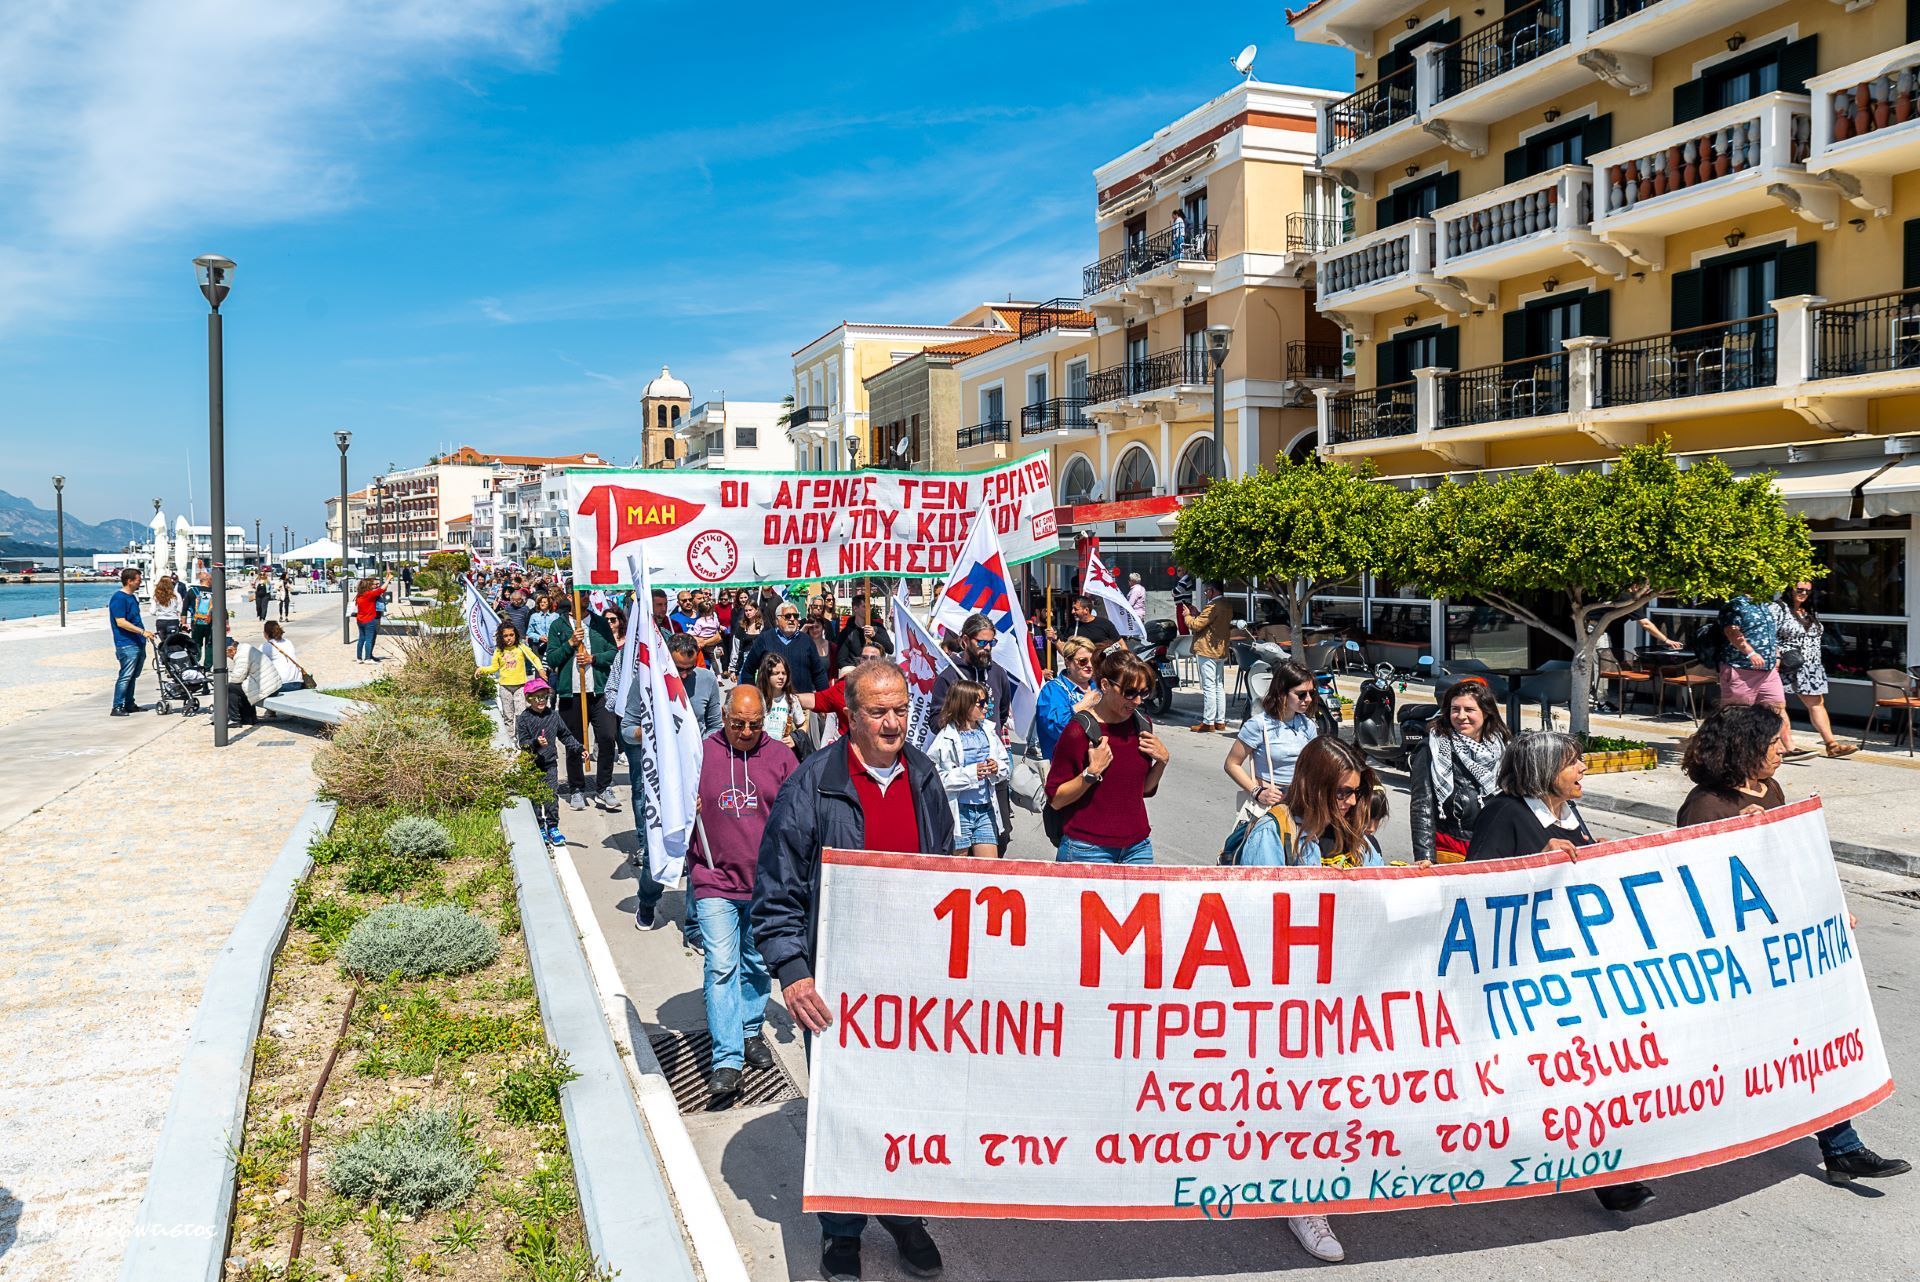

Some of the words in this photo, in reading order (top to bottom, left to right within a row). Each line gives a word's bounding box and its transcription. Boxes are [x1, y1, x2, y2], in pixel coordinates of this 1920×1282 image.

[627, 504, 676, 525] ΜΑΗ
[721, 480, 749, 508] ΟΙ
[772, 476, 877, 510] ΑΓΩΝΕΣ
[898, 478, 968, 510] ΤΩΝ
[692, 534, 722, 559] ΕΡΓΑΤΙΚΟ
[720, 540, 734, 574] ΚΕΝΤΡΟ
[764, 511, 837, 545] ΟΛΟΥ
[849, 508, 900, 541] ΤΟΥ
[695, 562, 717, 578] ΣΑΜΟΥ
[934, 886, 1027, 979] 1η
[1079, 890, 1336, 989] ΜΑΗ
[1437, 855, 1779, 977] ΑΠΕΡΓΙΑ
[839, 992, 1064, 1057] ΚΟΚΚΙΝΗ
[1108, 989, 1460, 1059] ΠΡΩΤΟΜΑΓΙΑ
[1483, 944, 1752, 1039] ΠΡΩΤΟΠΟΡΑ
[1767, 913, 1852, 988] ΕΡΓΑΤΙΑ
[1136, 1066, 1459, 1112] Αταλάντευτα
[1528, 1020, 1669, 1087] ταξικά
[884, 1132, 950, 1172] για
[980, 1134, 1067, 1166] την
[1096, 1119, 1401, 1165] ανασύνταξη
[1436, 1115, 1510, 1154] του
[1542, 1063, 1725, 1151] εργατικού
[1745, 1027, 1864, 1098] κινήματος
[1173, 1166, 1351, 1220] Εργατικό
[1368, 1160, 1485, 1203] Κέντρο
[1505, 1146, 1623, 1193] Σάμου
